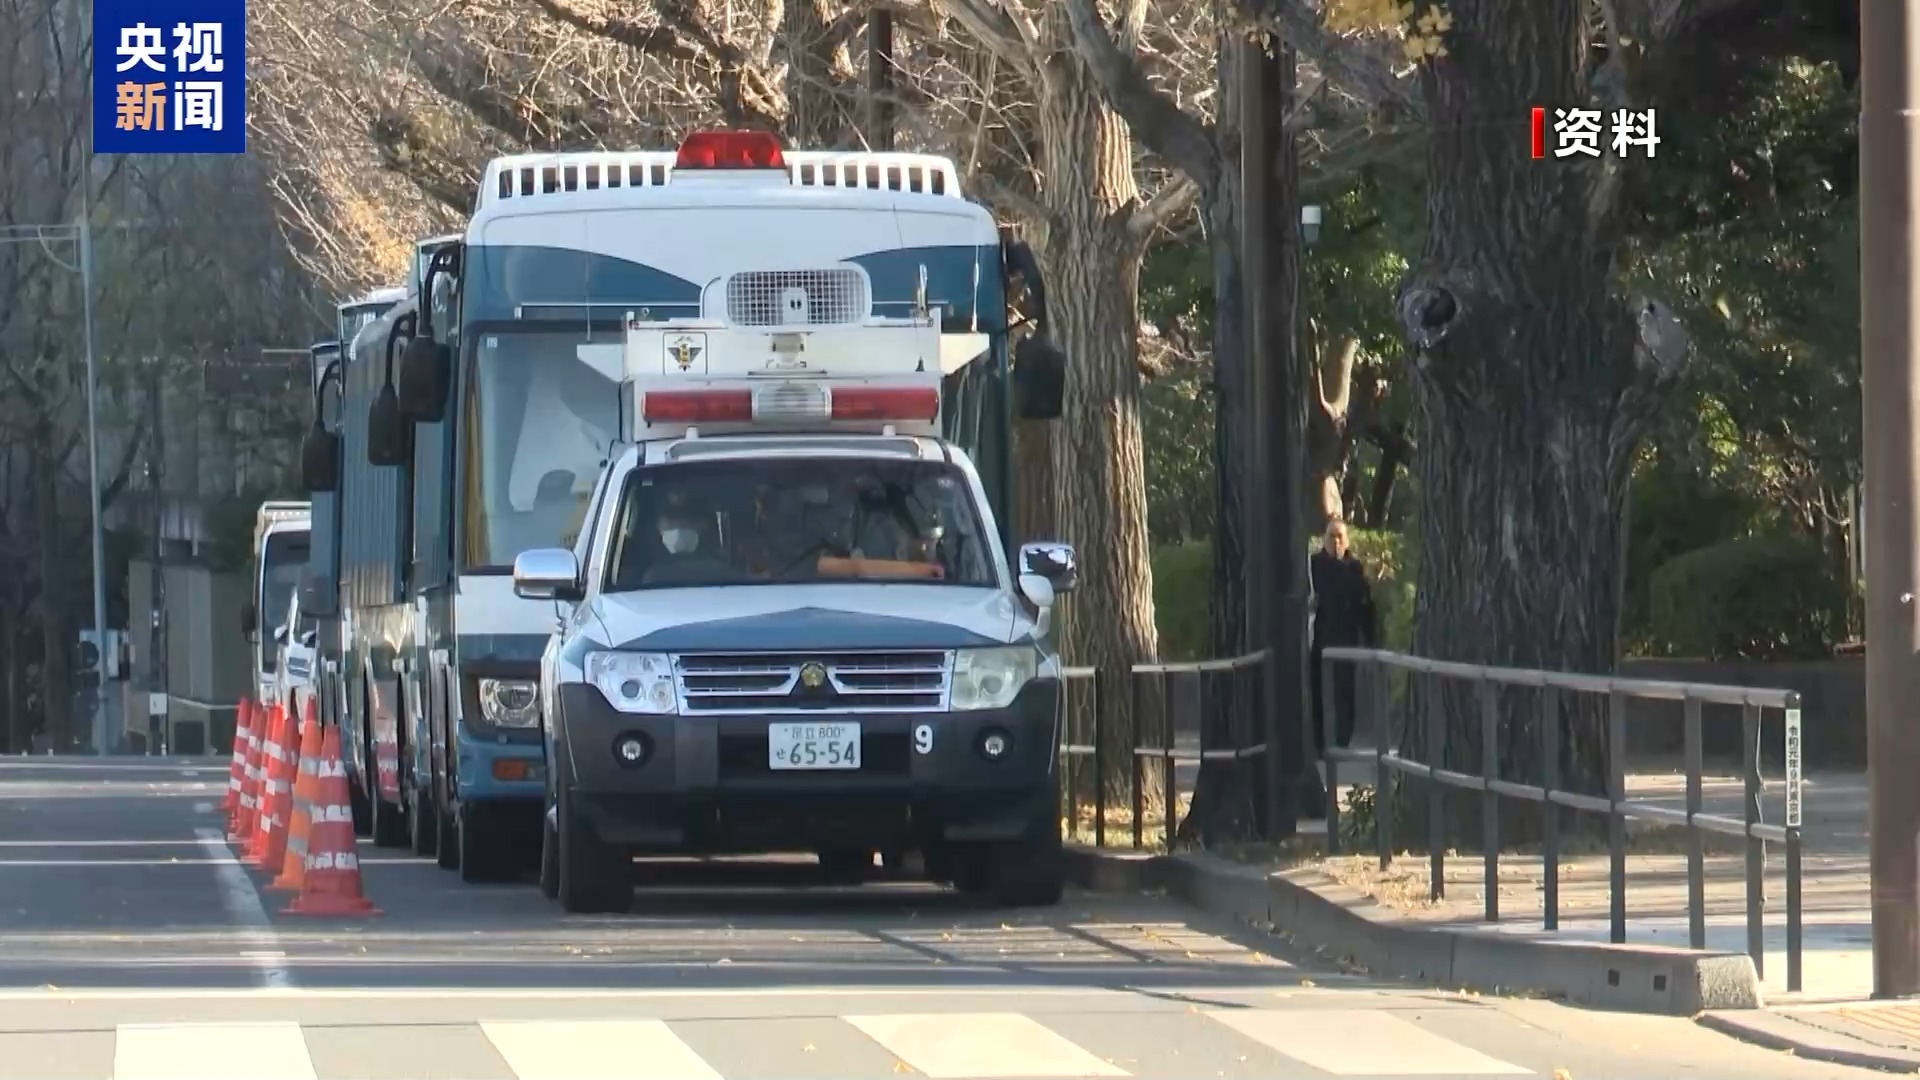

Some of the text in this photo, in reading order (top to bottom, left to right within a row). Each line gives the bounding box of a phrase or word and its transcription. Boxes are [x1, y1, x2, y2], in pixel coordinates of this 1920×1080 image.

[818, 727, 841, 739] 800
[915, 725, 933, 754] 9
[790, 741, 855, 765] 65-54
